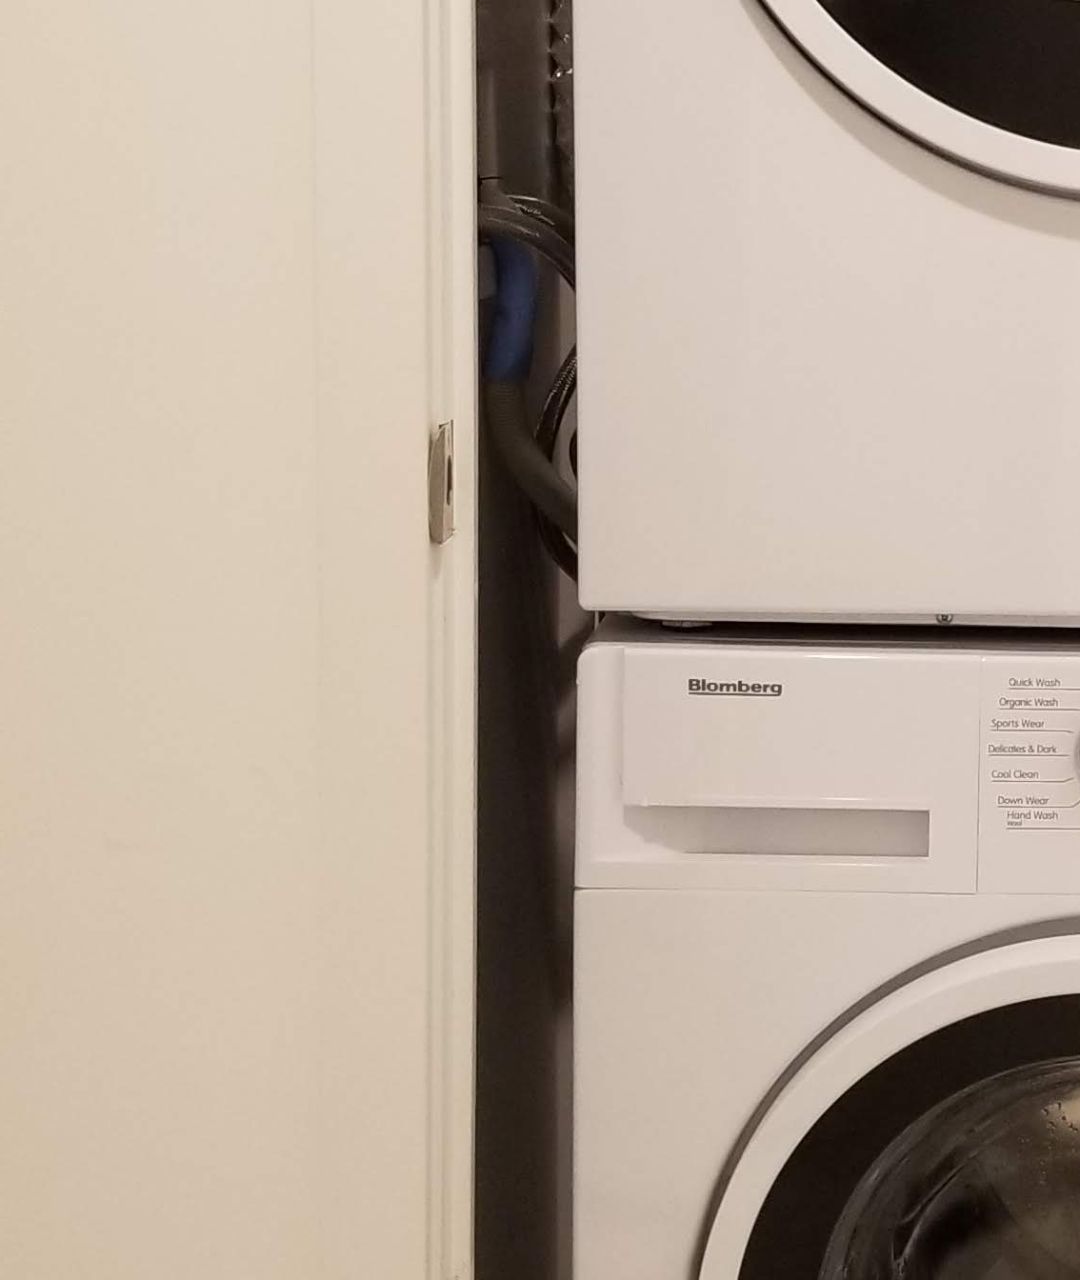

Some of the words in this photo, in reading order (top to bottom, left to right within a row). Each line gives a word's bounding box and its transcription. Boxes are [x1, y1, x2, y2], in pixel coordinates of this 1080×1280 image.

[687, 678, 783, 697] Blomberg
[1008, 678, 1034, 688] Quick
[1036, 678, 1061, 687] Wash
[999, 697, 1032, 709] Organic
[1034, 698, 1059, 707] Wash
[991, 719, 1019, 731] Sports
[1021, 719, 1045, 729] Wear
[988, 744, 1026, 754] Delicates
[1027, 744, 1035, 754] &
[1037, 744, 1057, 754] Dark
[991, 769, 1011, 779] Cool
[1013, 769, 1039, 779] Clean
[997, 796, 1023, 805] Down
[1025, 796, 1050, 805] Wear
[1006, 810, 1031, 820] Hand
[1033, 811, 1059, 820] Wash
